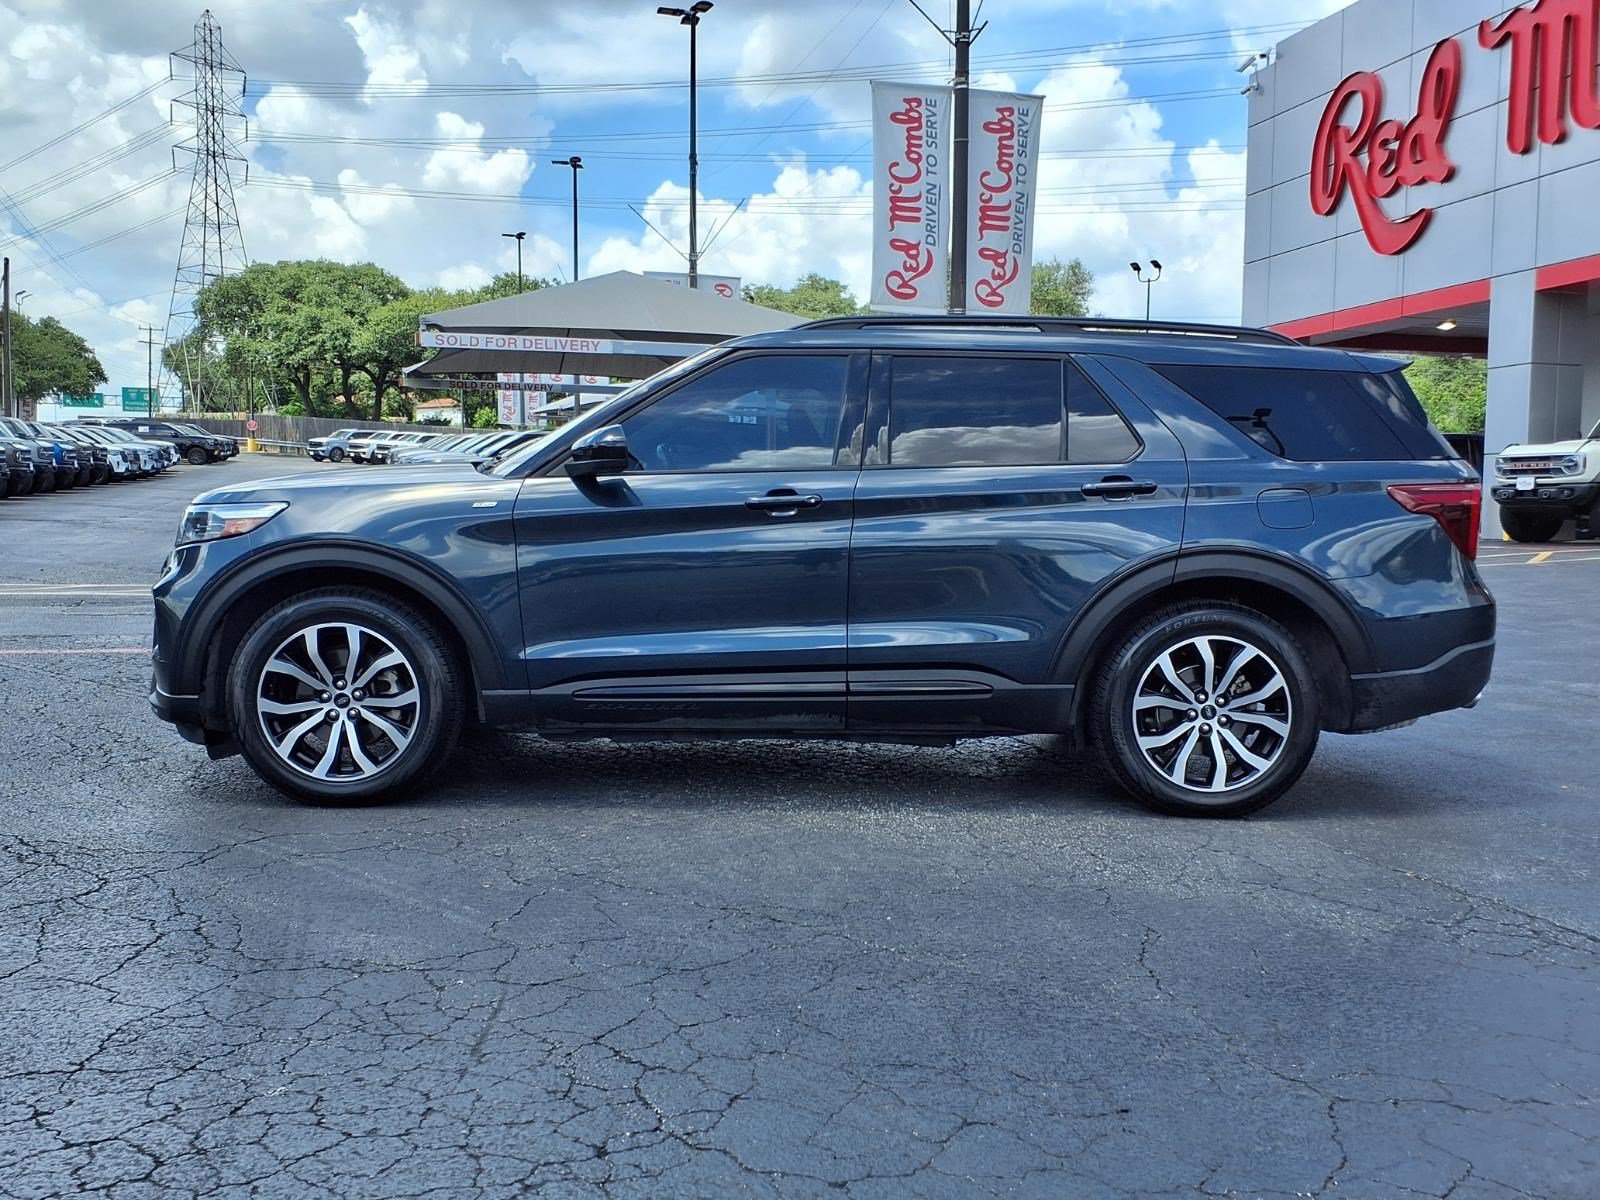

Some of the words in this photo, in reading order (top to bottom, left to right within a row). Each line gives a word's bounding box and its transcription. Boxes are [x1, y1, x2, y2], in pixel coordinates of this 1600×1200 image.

[925, 97, 938, 149] SERVE
[1017, 107, 1030, 160] SERVE
[1310, 38, 1463, 255] Red
[888, 97, 924, 232] McCombs
[925, 154, 938, 177] TO
[978, 106, 1015, 241] McCombs
[1015, 164, 1028, 186] TO
[925, 182, 938, 247] DRIVEN
[1012, 194, 1026, 255] DRIVEN
[885, 238, 934, 300] Red
[974, 247, 1019, 308] Red
[435, 334, 480, 347] SOLD
[485, 337, 518, 349] FOR
[523, 339, 600, 352] DELIVERY
[450, 380, 477, 390] SOLD
[480, 382, 501, 391] FOR
[504, 383, 554, 392] DELIVERY
